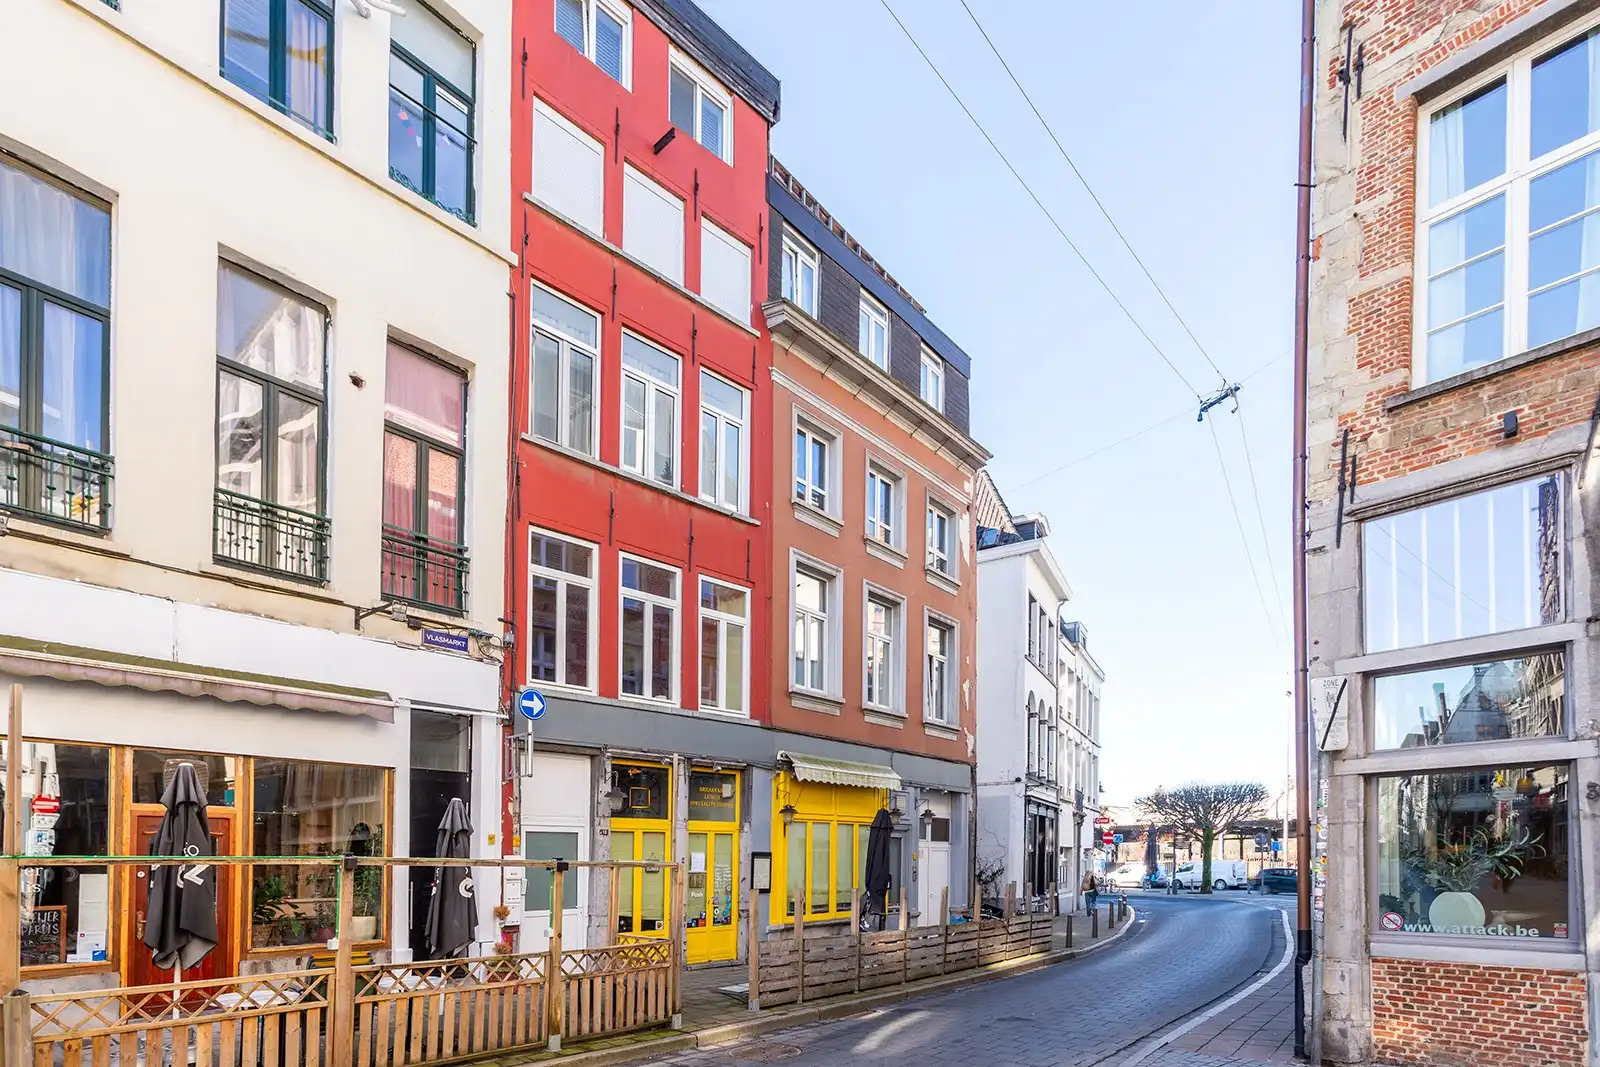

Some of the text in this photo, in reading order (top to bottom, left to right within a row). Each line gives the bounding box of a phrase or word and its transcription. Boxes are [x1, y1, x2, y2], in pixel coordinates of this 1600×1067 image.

[425, 633, 466, 648] VLASMARKT
[1323, 679, 1339, 688] ZONE
[1404, 922, 1540, 938] www.attack.be
